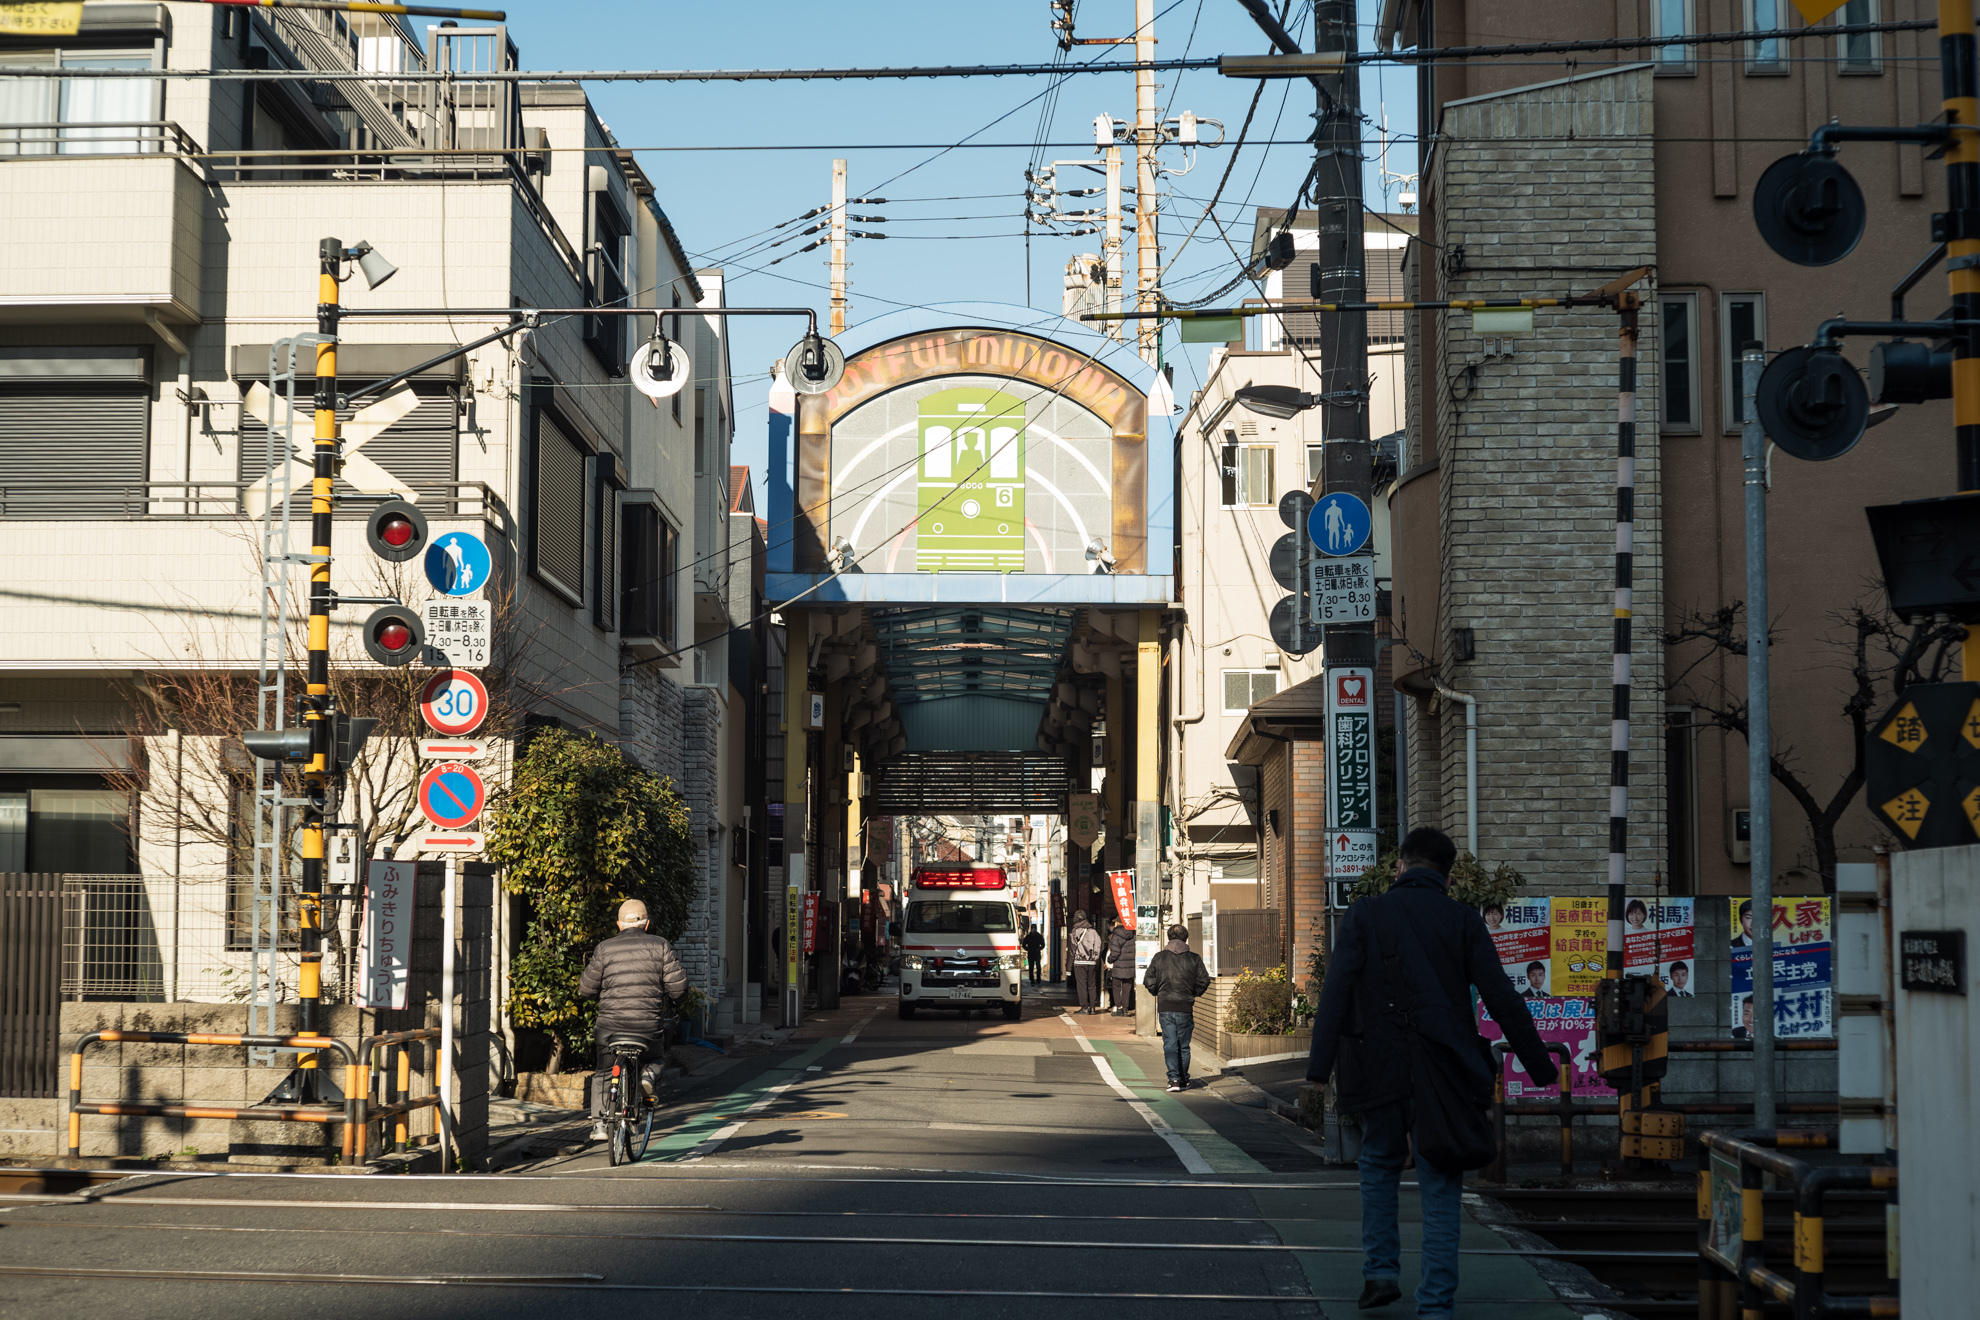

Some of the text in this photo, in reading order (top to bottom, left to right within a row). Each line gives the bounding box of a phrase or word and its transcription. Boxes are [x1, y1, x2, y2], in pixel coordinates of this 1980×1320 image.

[998, 489, 1010, 504] 6
[1314, 563, 1369, 578] 自転車を除く
[428, 606, 486, 618] 自転車を除く
[437, 688, 473, 716] 30
[441, 764, 464, 774] 8-20
[1338, 716, 1354, 826] 歯科クリニック
[1354, 716, 1369, 811] アクロシティ
[1335, 854, 1375, 862] アクロシティ内
[1335, 864, 1374, 873] 03-3891-4
[1506, 906, 1538, 924] 相馬
[1556, 909, 1608, 923] 医療費ゼ
[1649, 906, 1681, 924] 相馬
[1772, 901, 1823, 929] 久家
[374, 866, 400, 1002] ふみきりちゅうい
[1492, 929, 1549, 942] たの声をまっすぐ区政へ
[1789, 930, 1824, 944] しげる
[1745, 960, 1817, 980] 立民主党
[1774, 990, 1824, 1022] 木村
[1778, 1020, 1824, 1036] たけつか
